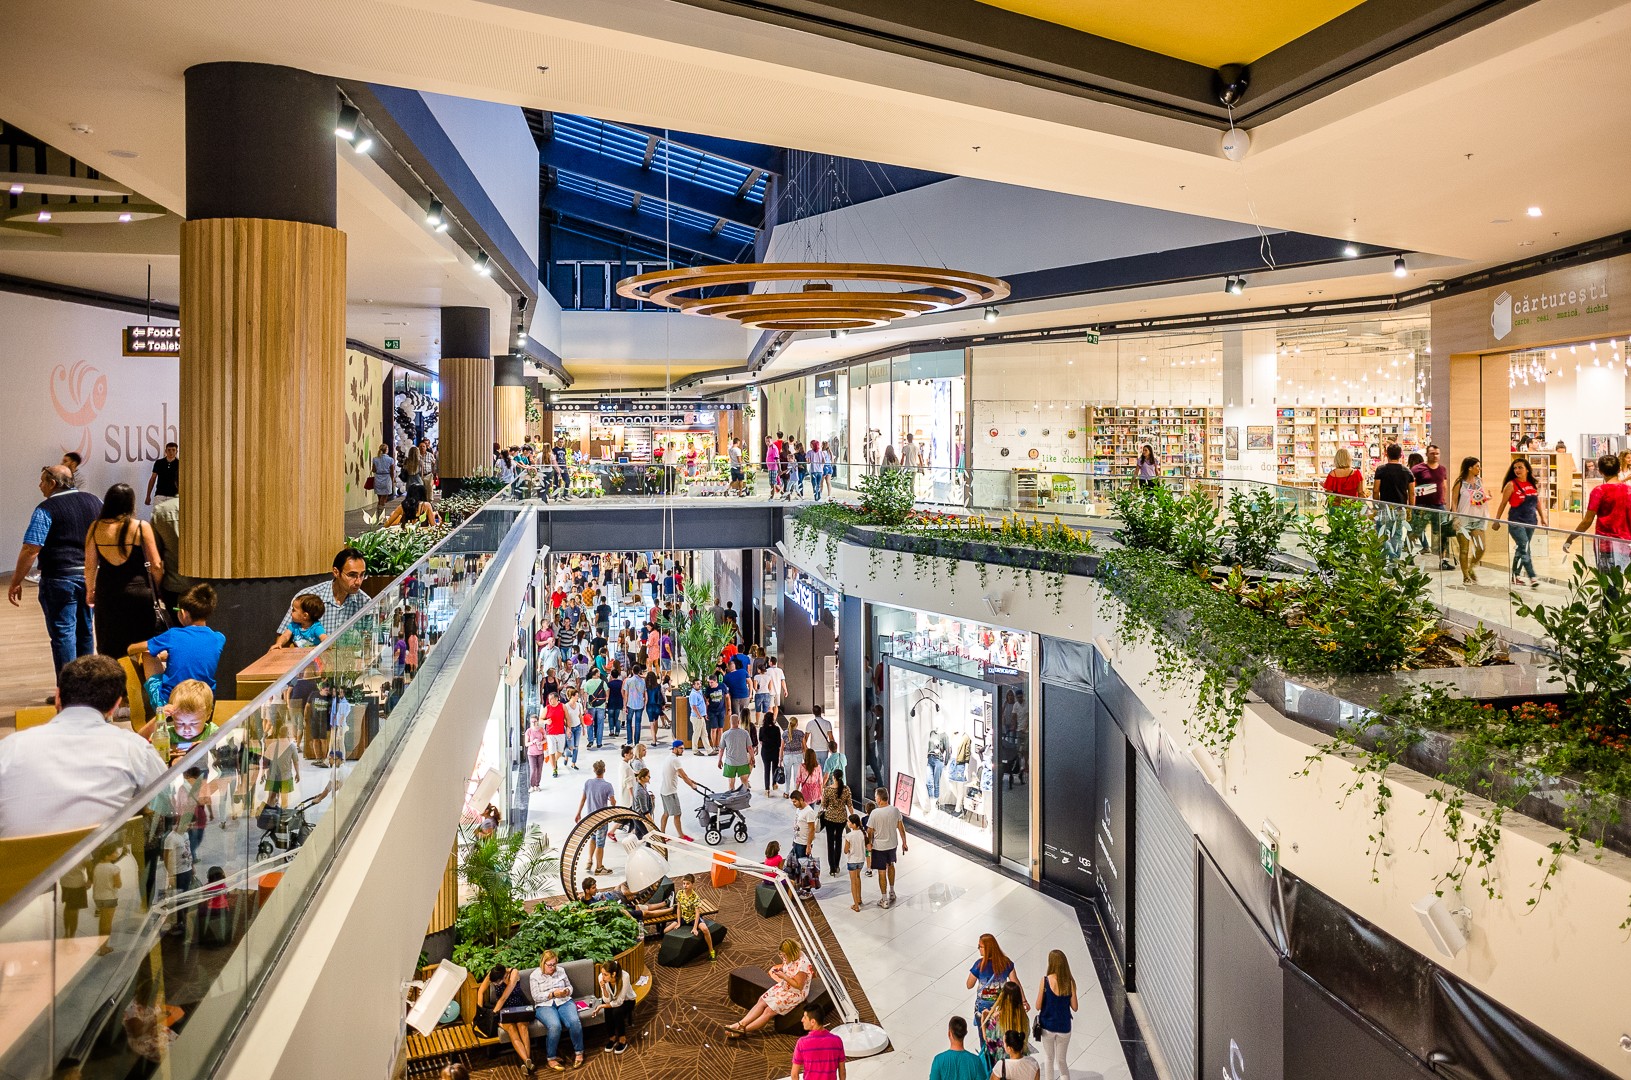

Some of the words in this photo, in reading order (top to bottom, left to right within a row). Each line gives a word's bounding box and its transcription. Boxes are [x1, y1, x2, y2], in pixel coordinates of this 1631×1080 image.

[1585, 303, 1609, 315] dichis
[147, 327, 173, 337] Food
[147, 340, 180, 351] Toalet
[1042, 454, 1056, 463] like
